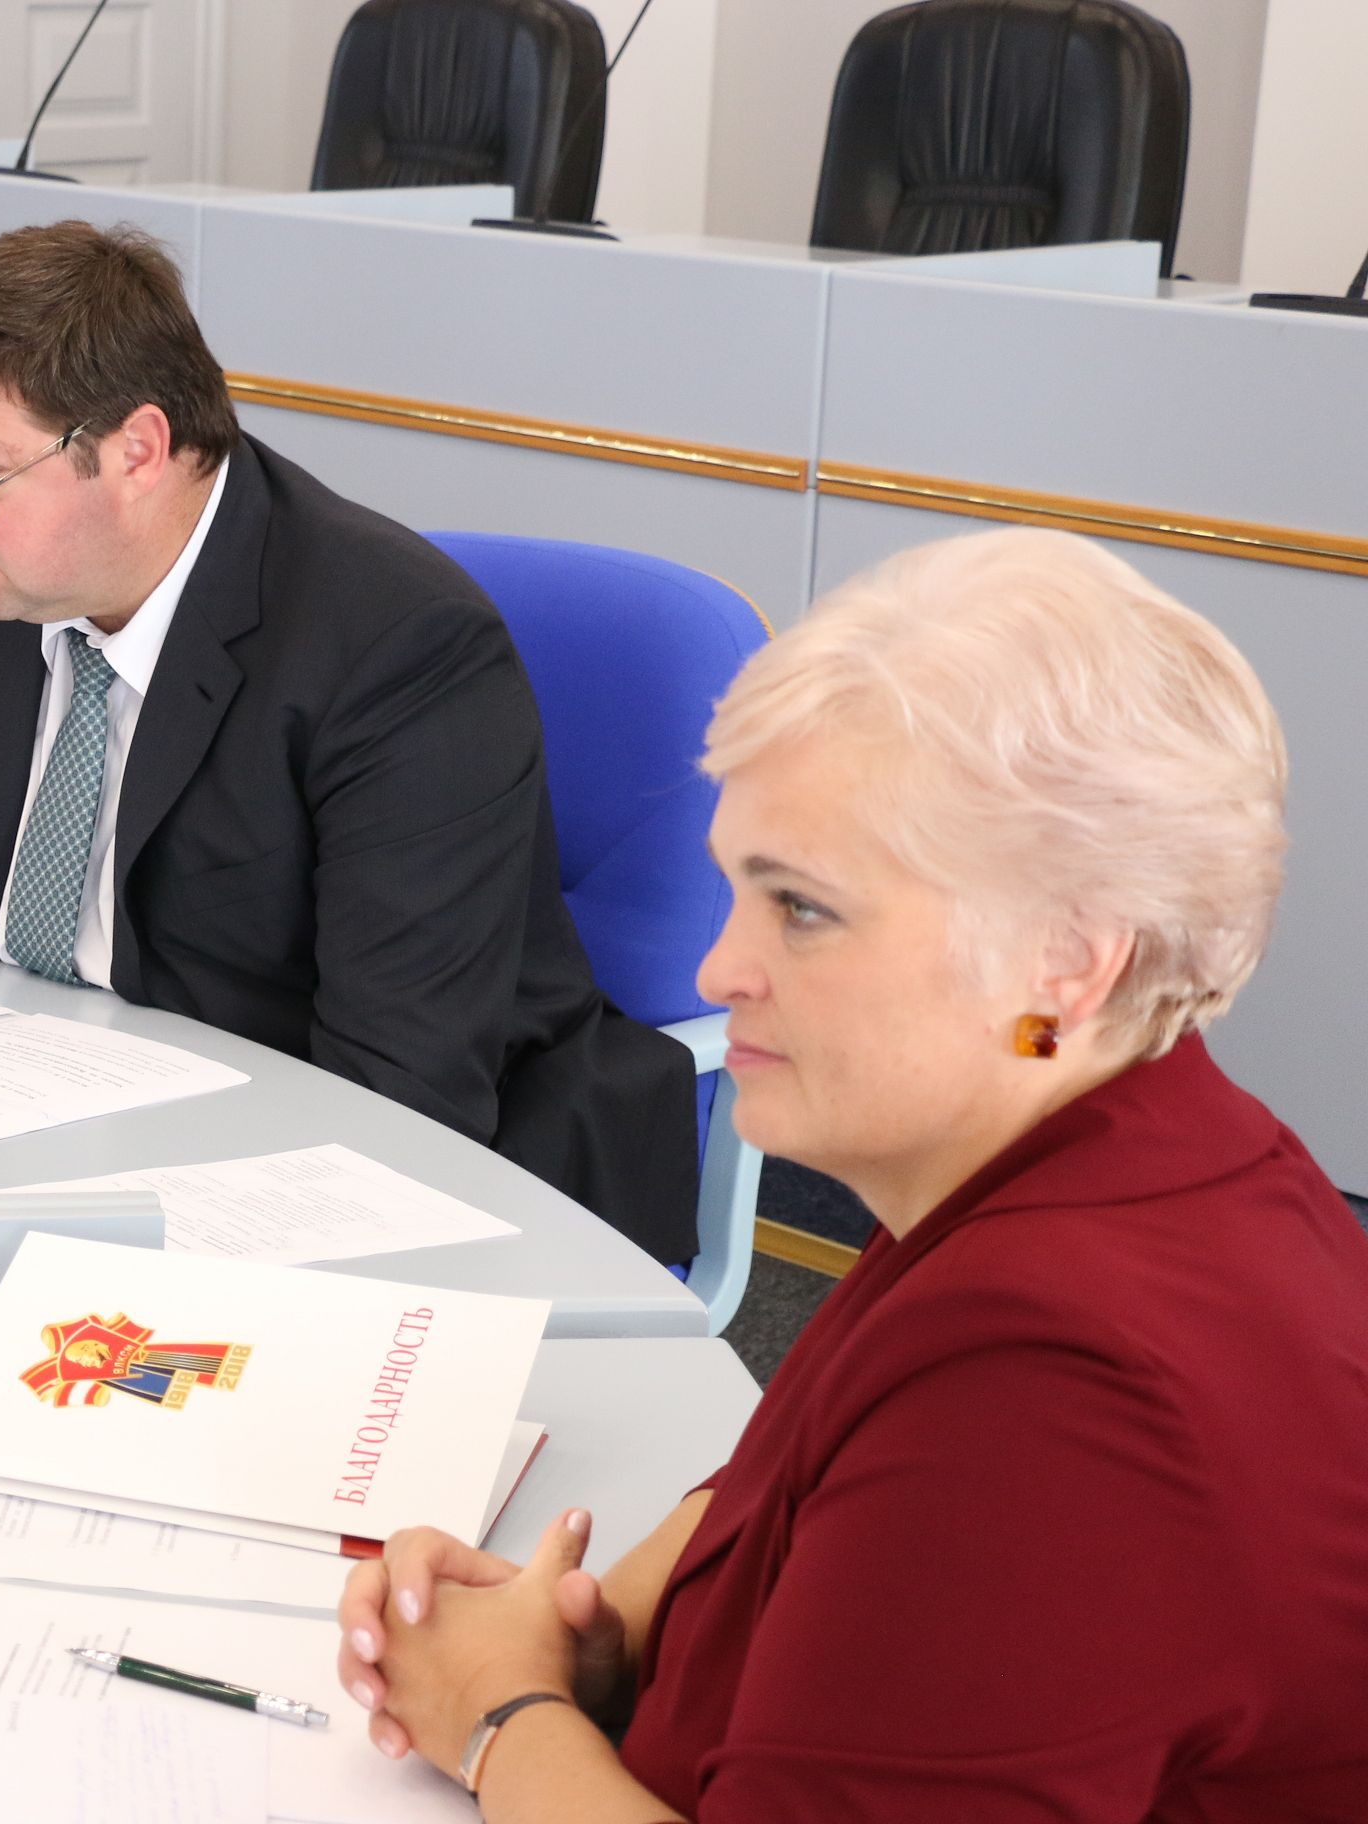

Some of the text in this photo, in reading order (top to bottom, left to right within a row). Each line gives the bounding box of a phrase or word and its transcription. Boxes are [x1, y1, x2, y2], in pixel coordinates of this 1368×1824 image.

[113, 1343, 136, 1375] ВЛКСМ
[219, 1344, 252, 1390] 2018
[164, 1372, 196, 1410] 1918
[333, 1307, 434, 1506] БЛАГОДАРНОСТЬ
